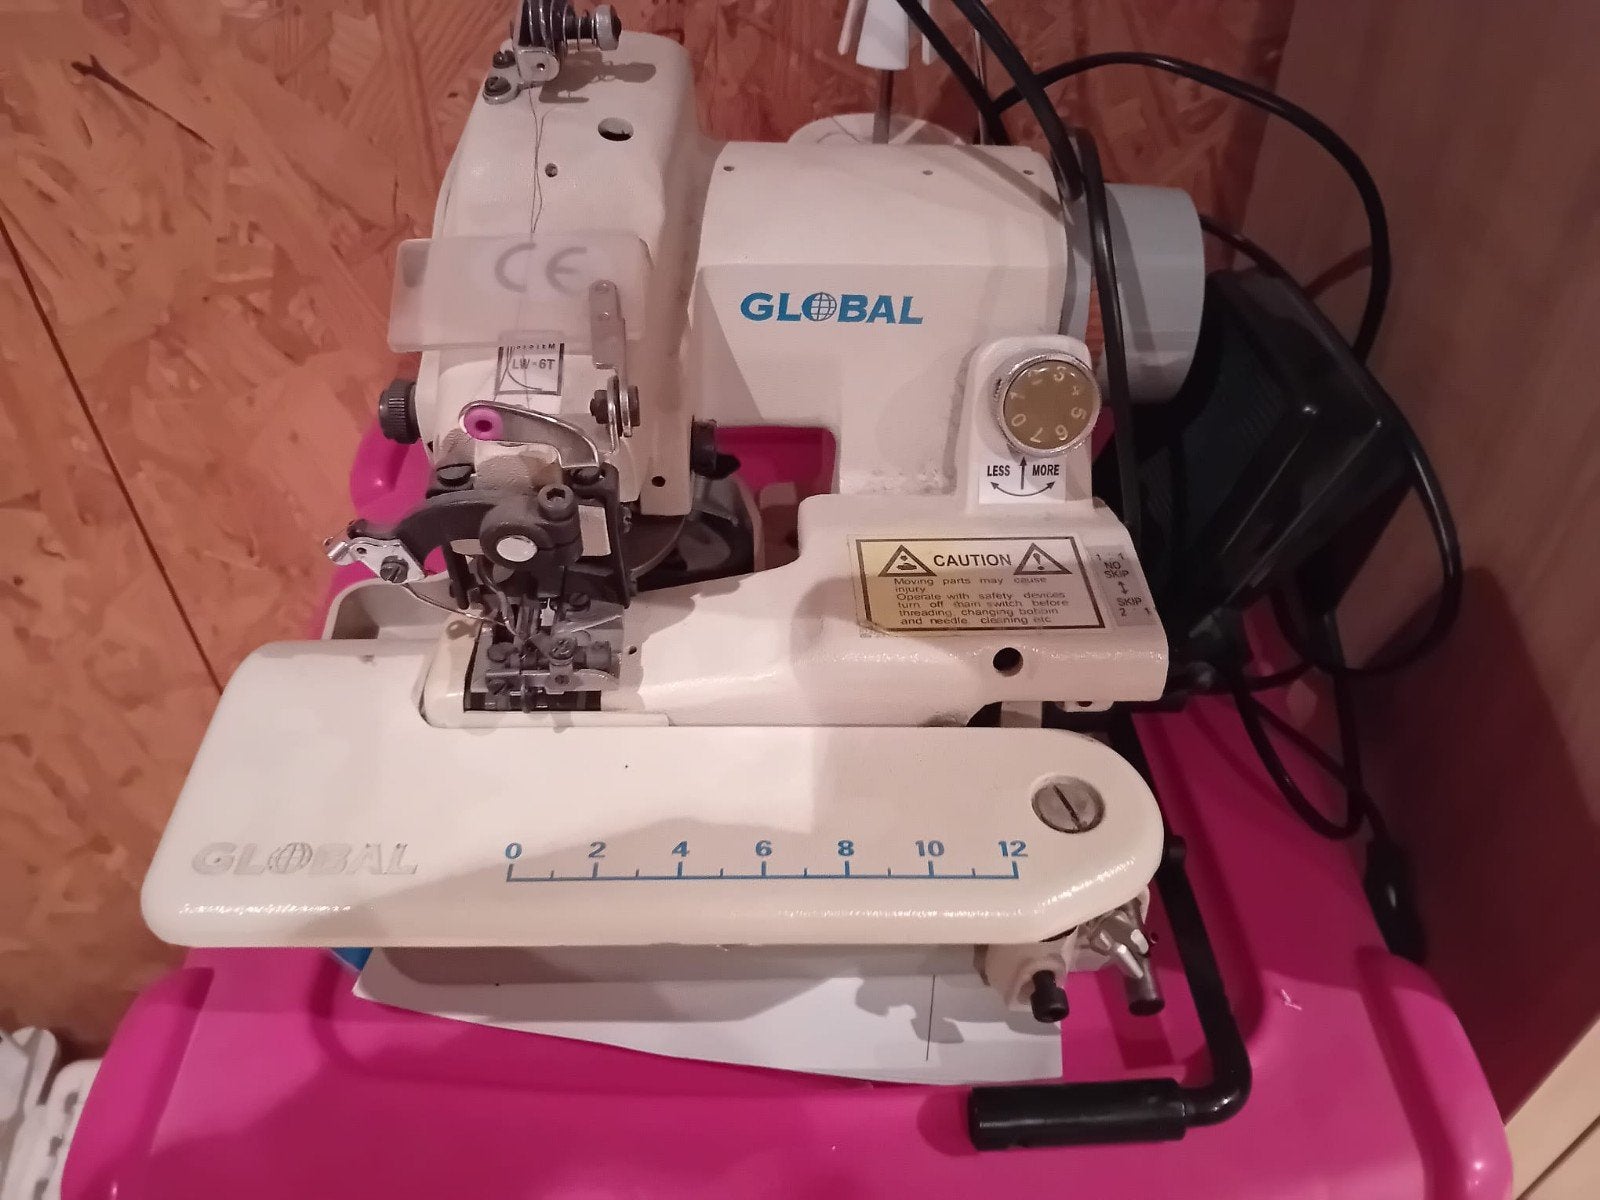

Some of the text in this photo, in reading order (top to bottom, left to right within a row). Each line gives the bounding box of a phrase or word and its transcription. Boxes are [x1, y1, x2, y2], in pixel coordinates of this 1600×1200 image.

[740, 292, 924, 325] GLOBAL
[512, 358, 556, 370] LW-6T
[1011, 413, 1027, 427] 0
[1030, 427, 1044, 443] 7
[987, 465, 1011, 477] LESS
[1032, 464, 1060, 476] MORE
[933, 554, 1012, 567] CAUTION
[1104, 561, 1121, 570] NO
[1103, 570, 1129, 578] SKIP
[894, 578, 934, 587] Moving
[943, 578, 971, 586] parts
[895, 586, 926, 594] injury
[897, 591, 1066, 601] Operate with safety devices
[1116, 597, 1142, 606] SKIP
[898, 601, 920, 609] turn
[930, 600, 943, 608] off
[1031, 599, 1069, 607] before
[899, 609, 952, 618] threading
[961, 608, 1014, 617] changing
[900, 617, 922, 625] and
[930, 617, 968, 625] needle
[980, 616, 1028, 625] cleaning
[505, 840, 1029, 860] 0 2 4 6 8 10 12
[191, 841, 419, 876] GLOBAL
